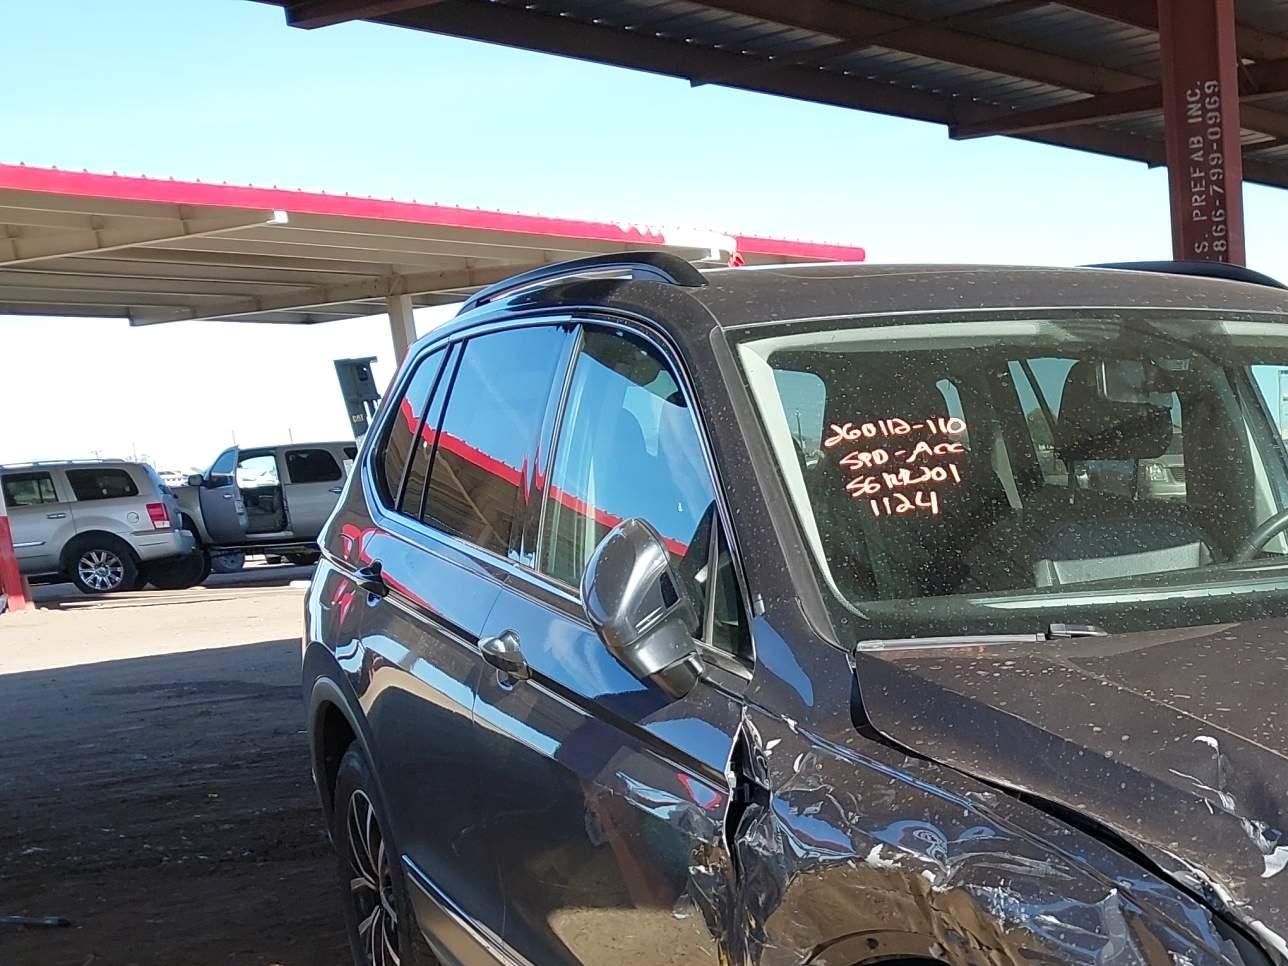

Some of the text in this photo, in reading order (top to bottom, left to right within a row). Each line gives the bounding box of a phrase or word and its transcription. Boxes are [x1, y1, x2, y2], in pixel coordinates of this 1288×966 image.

[1186, 80, 1210, 261] .S. PREFAB INC.
[1204, 79, 1229, 263] -866-799-0969
[869, 490, 940, 517] 1124
